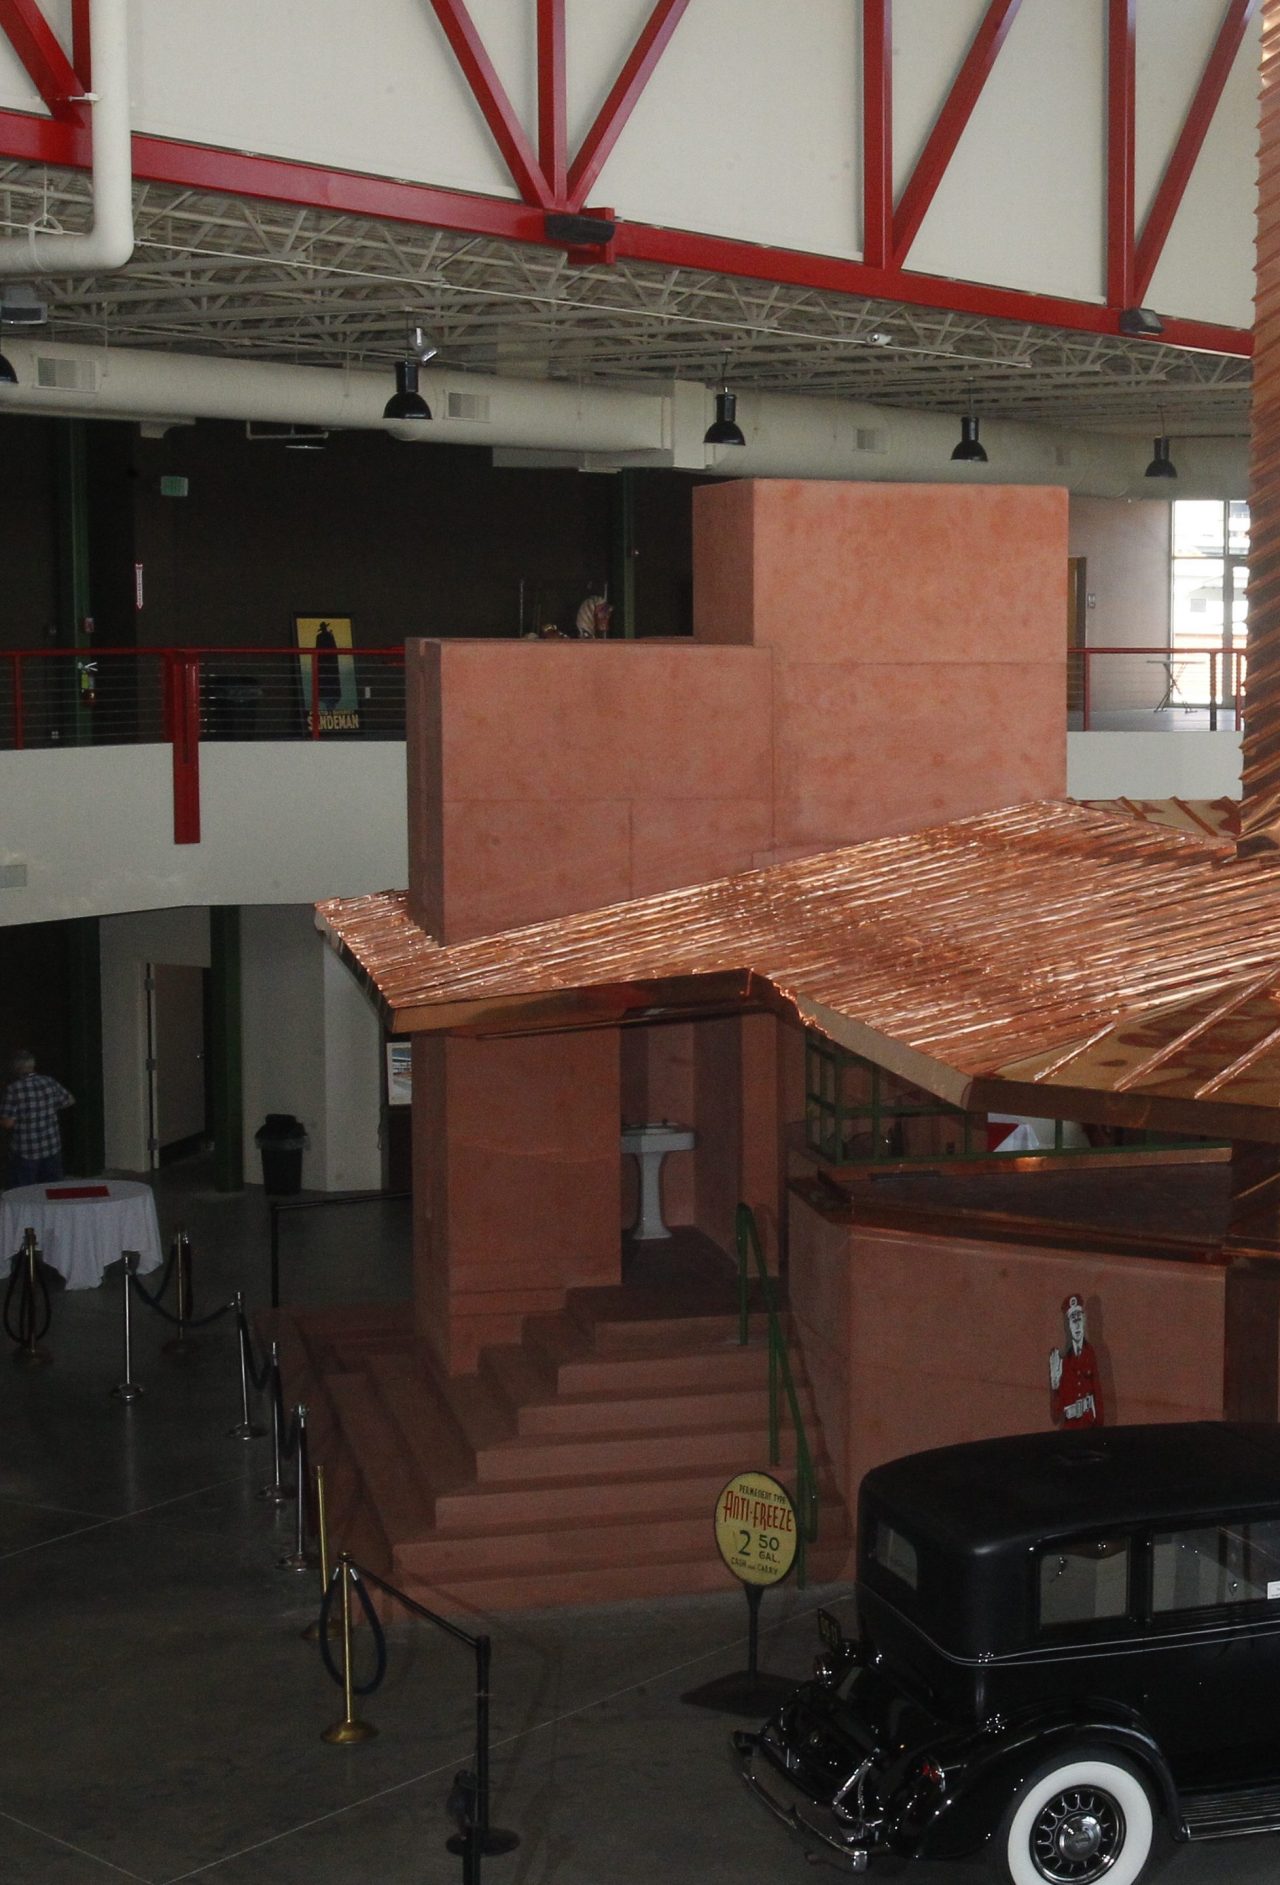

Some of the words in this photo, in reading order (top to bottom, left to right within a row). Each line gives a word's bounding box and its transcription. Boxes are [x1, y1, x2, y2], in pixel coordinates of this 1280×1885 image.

[307, 714, 360, 731] SNDEMAN
[738, 1529, 751, 1556] 2
[758, 1534, 780, 1551] 50
[758, 1551, 780, 1564] GAL.
